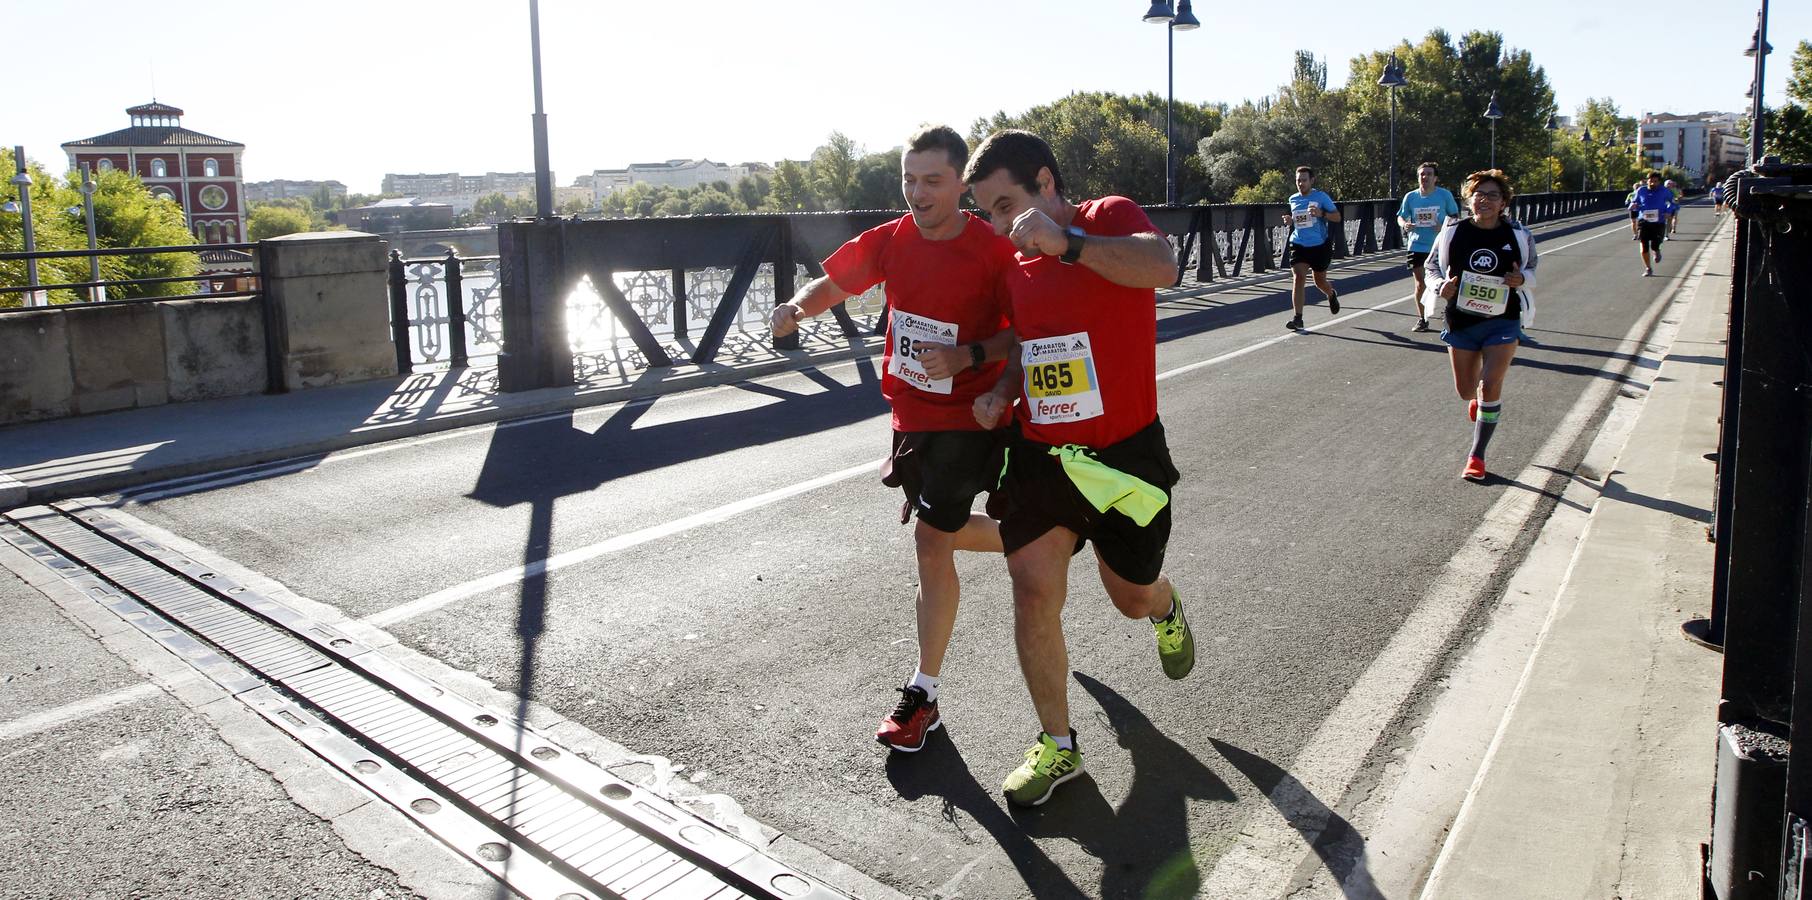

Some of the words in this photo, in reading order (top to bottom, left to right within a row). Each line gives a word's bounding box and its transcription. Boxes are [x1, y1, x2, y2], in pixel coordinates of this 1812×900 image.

[1469, 285, 1497, 299] 550
[1038, 342, 1066, 350] MARATON
[1032, 363, 1073, 390] 465
[1037, 400, 1078, 417] ferrer
